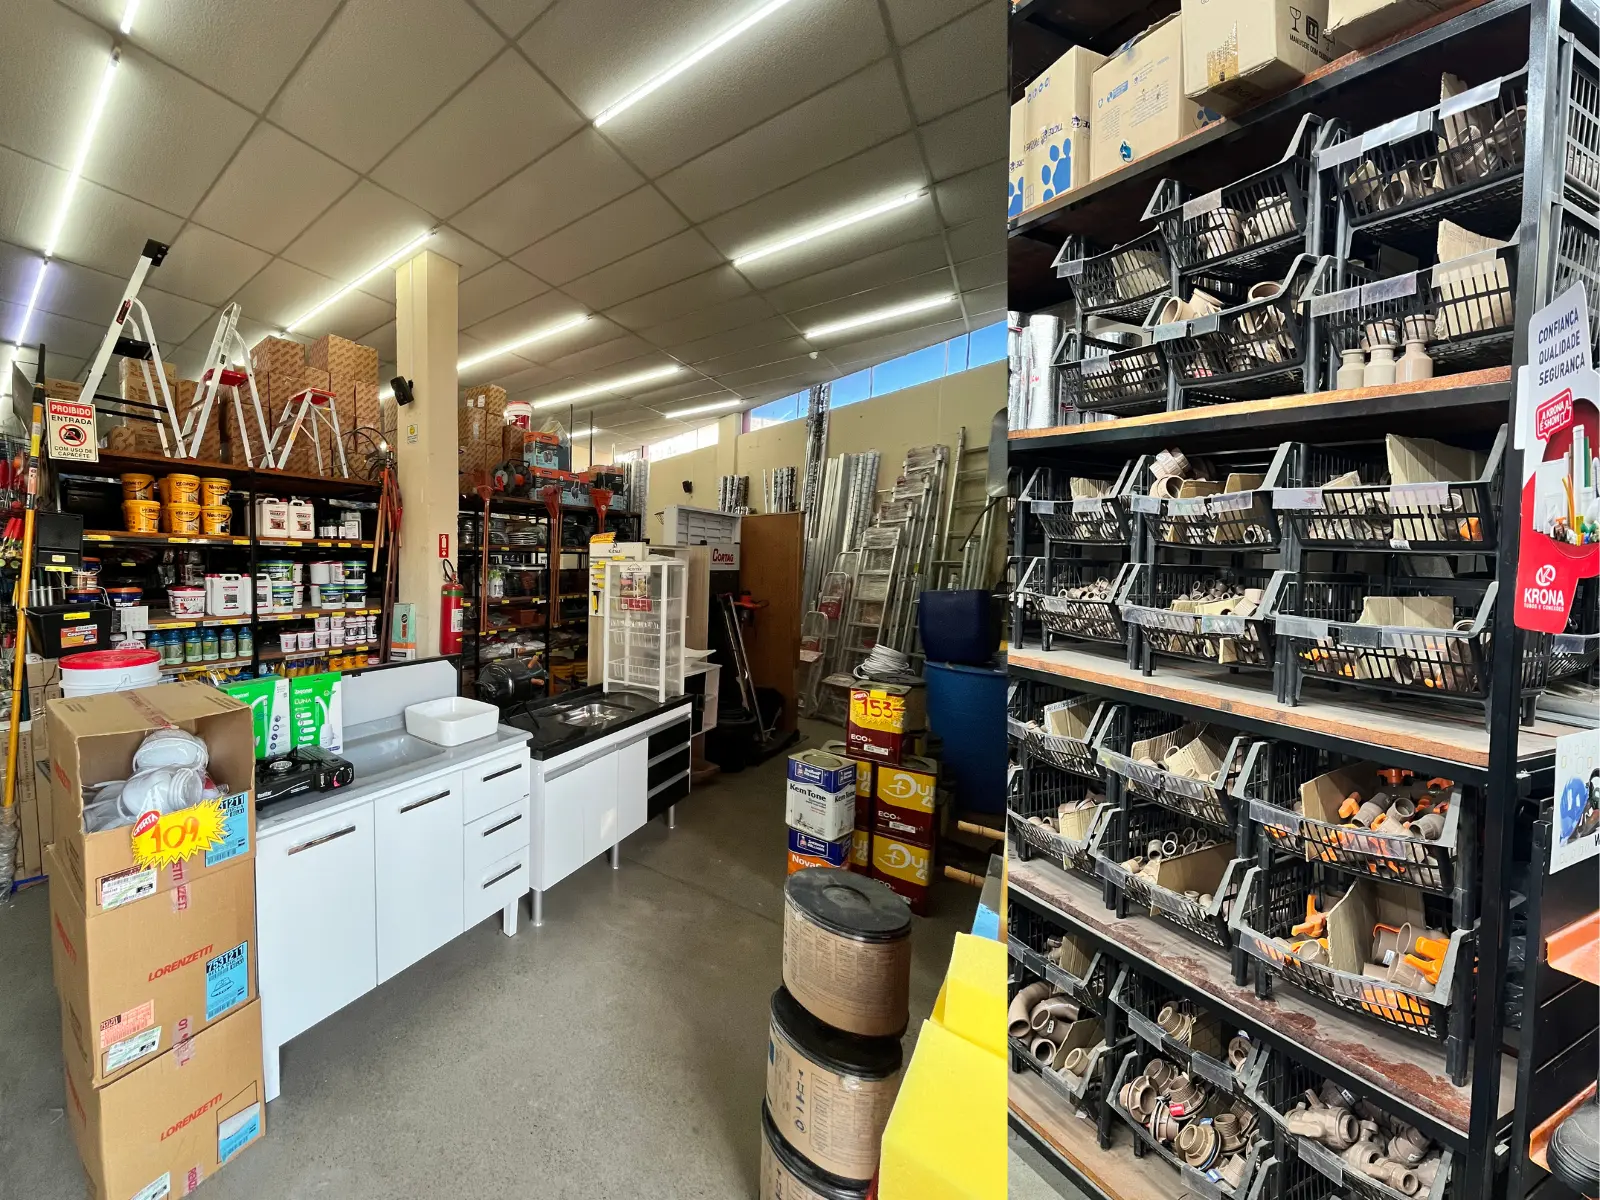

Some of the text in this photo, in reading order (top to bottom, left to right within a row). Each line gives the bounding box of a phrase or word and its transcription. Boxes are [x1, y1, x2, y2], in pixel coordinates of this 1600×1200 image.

[1538, 307, 1579, 344] CONFIANÇA
[1538, 330, 1581, 366] QUALIDADE
[1538, 352, 1585, 387] SEGURANÇA
[51, 404, 91, 416] PROIBIDO
[1546, 400, 1565, 419] KRONA
[51, 415, 92, 425] ENTRADA
[1524, 587, 1565, 606] KRONA
[789, 783, 827, 802] Kem Tone
[877, 810, 902, 821] ECO+
[148, 943, 213, 982] LORENZETTI
[160, 1092, 223, 1142] LORENZETTI
